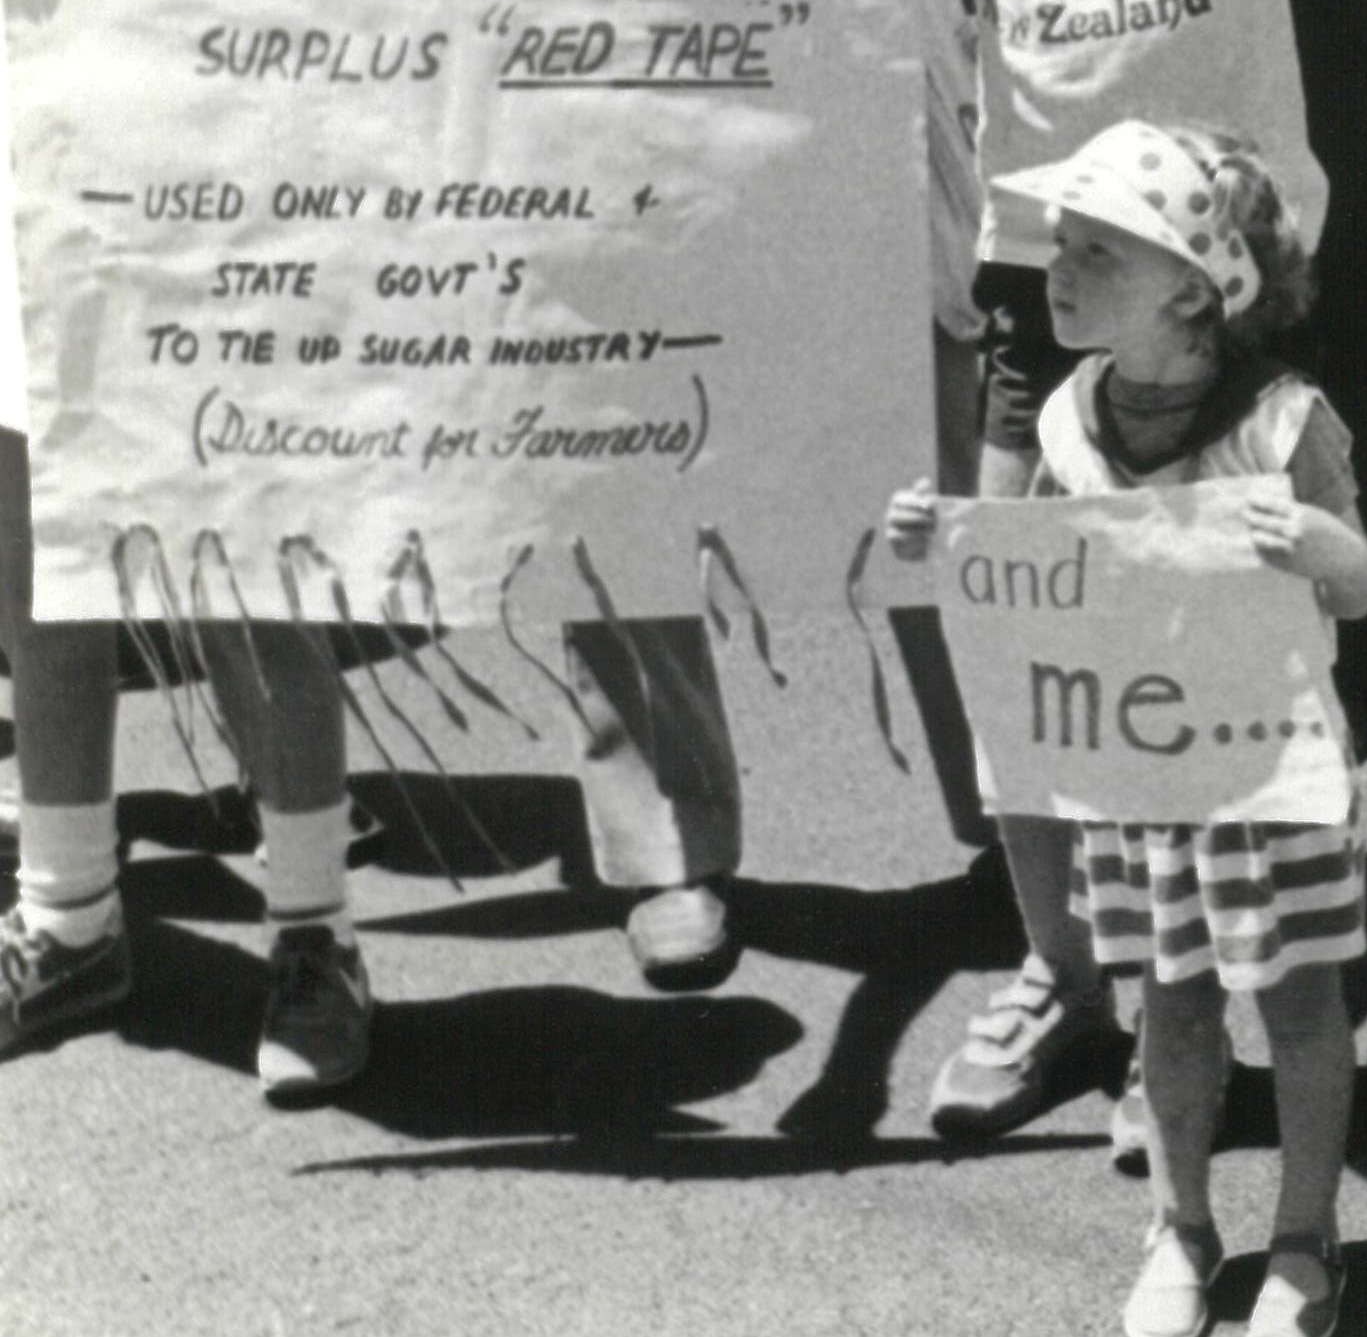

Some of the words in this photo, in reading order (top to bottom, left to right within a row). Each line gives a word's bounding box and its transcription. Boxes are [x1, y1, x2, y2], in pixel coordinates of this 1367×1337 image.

[194, 24, 451, 83] SURPLUS
[272, 186, 366, 222] ONLY
[433, 185, 597, 222] FEDERAL
[211, 263, 318, 300] STATE
[145, 324, 200, 367] TO
[217, 329, 277, 365] TIE
[297, 331, 341, 365] UP
[358, 333, 473, 368] SUGAR
[423, 422, 481, 471] for
[959, 536, 1087, 609] and
